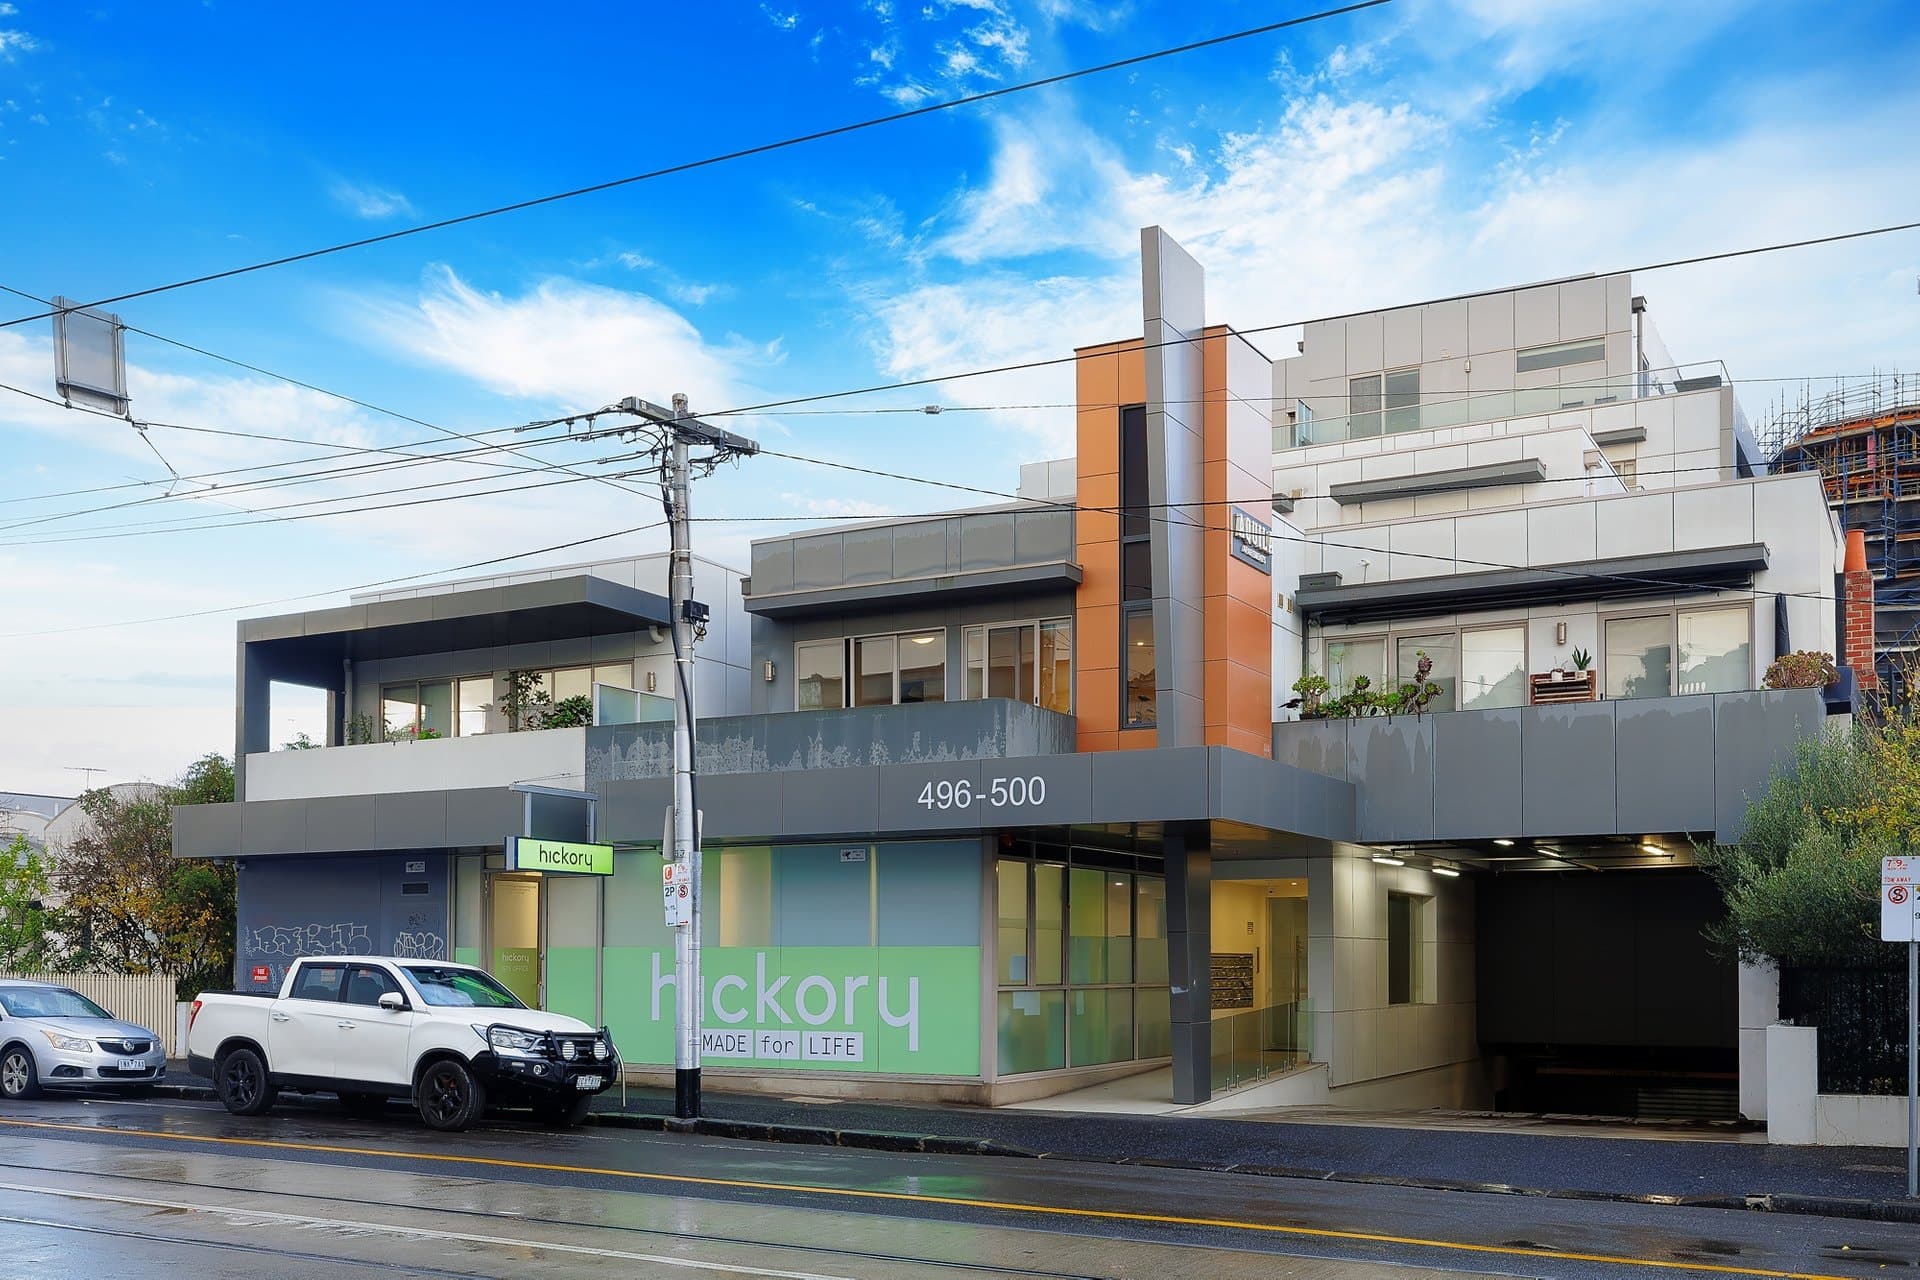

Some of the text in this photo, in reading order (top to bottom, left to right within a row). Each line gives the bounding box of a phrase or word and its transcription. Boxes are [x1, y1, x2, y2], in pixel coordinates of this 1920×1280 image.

[917, 776, 1046, 810] 496-500
[539, 843, 593, 872] hickory
[664, 886, 675, 897] 2P
[702, 1034, 856, 1056] MADE for LIFE
